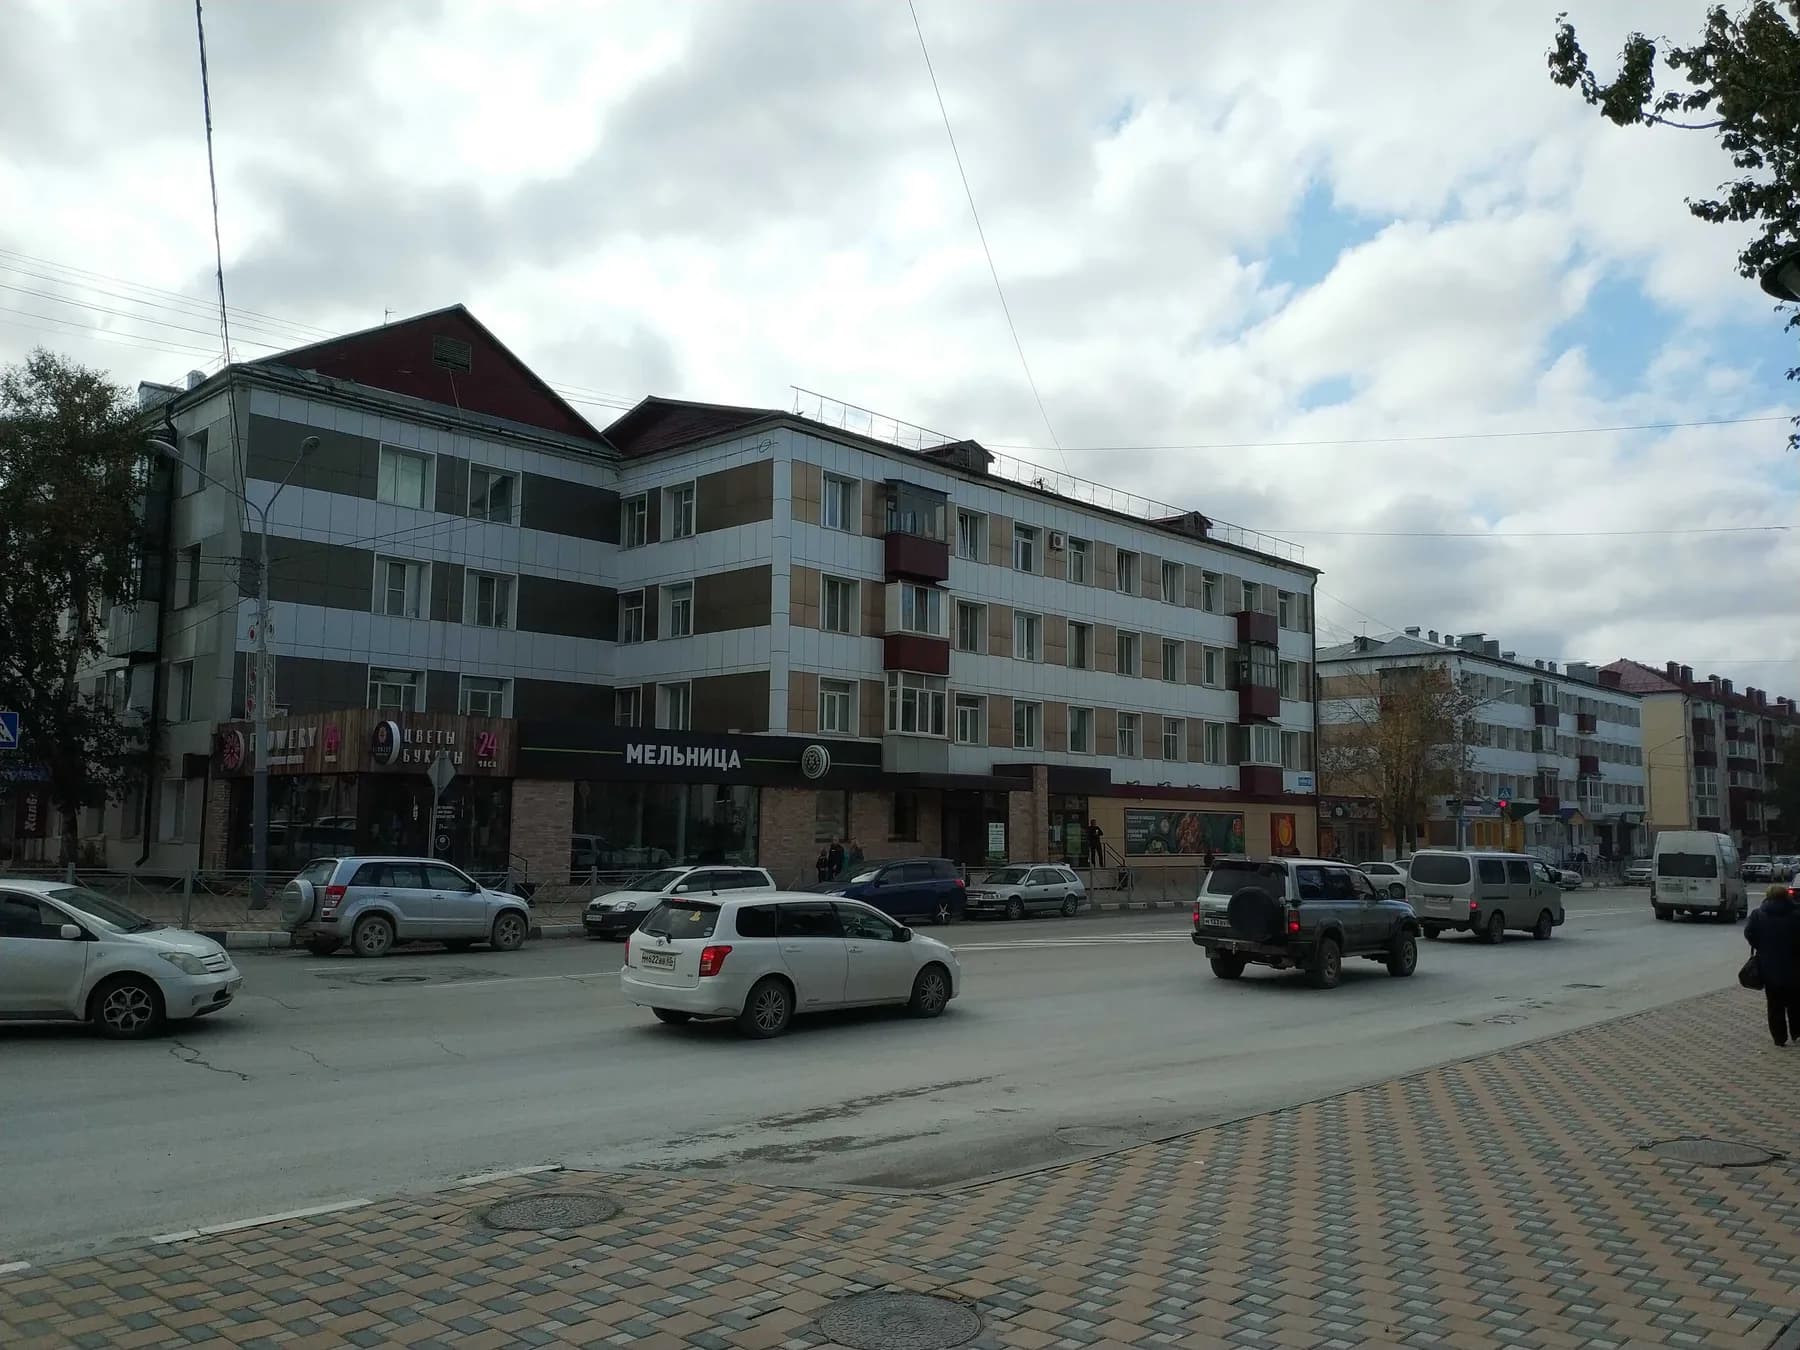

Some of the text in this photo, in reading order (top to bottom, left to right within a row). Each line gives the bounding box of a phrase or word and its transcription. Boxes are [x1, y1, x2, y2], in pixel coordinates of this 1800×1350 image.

[249, 727, 317, 753] FOWERY
[404, 728, 455, 745] ЦВЕТЫ
[479, 731, 497, 757] 24
[626, 743, 742, 771] МЕЛЬНИЦА
